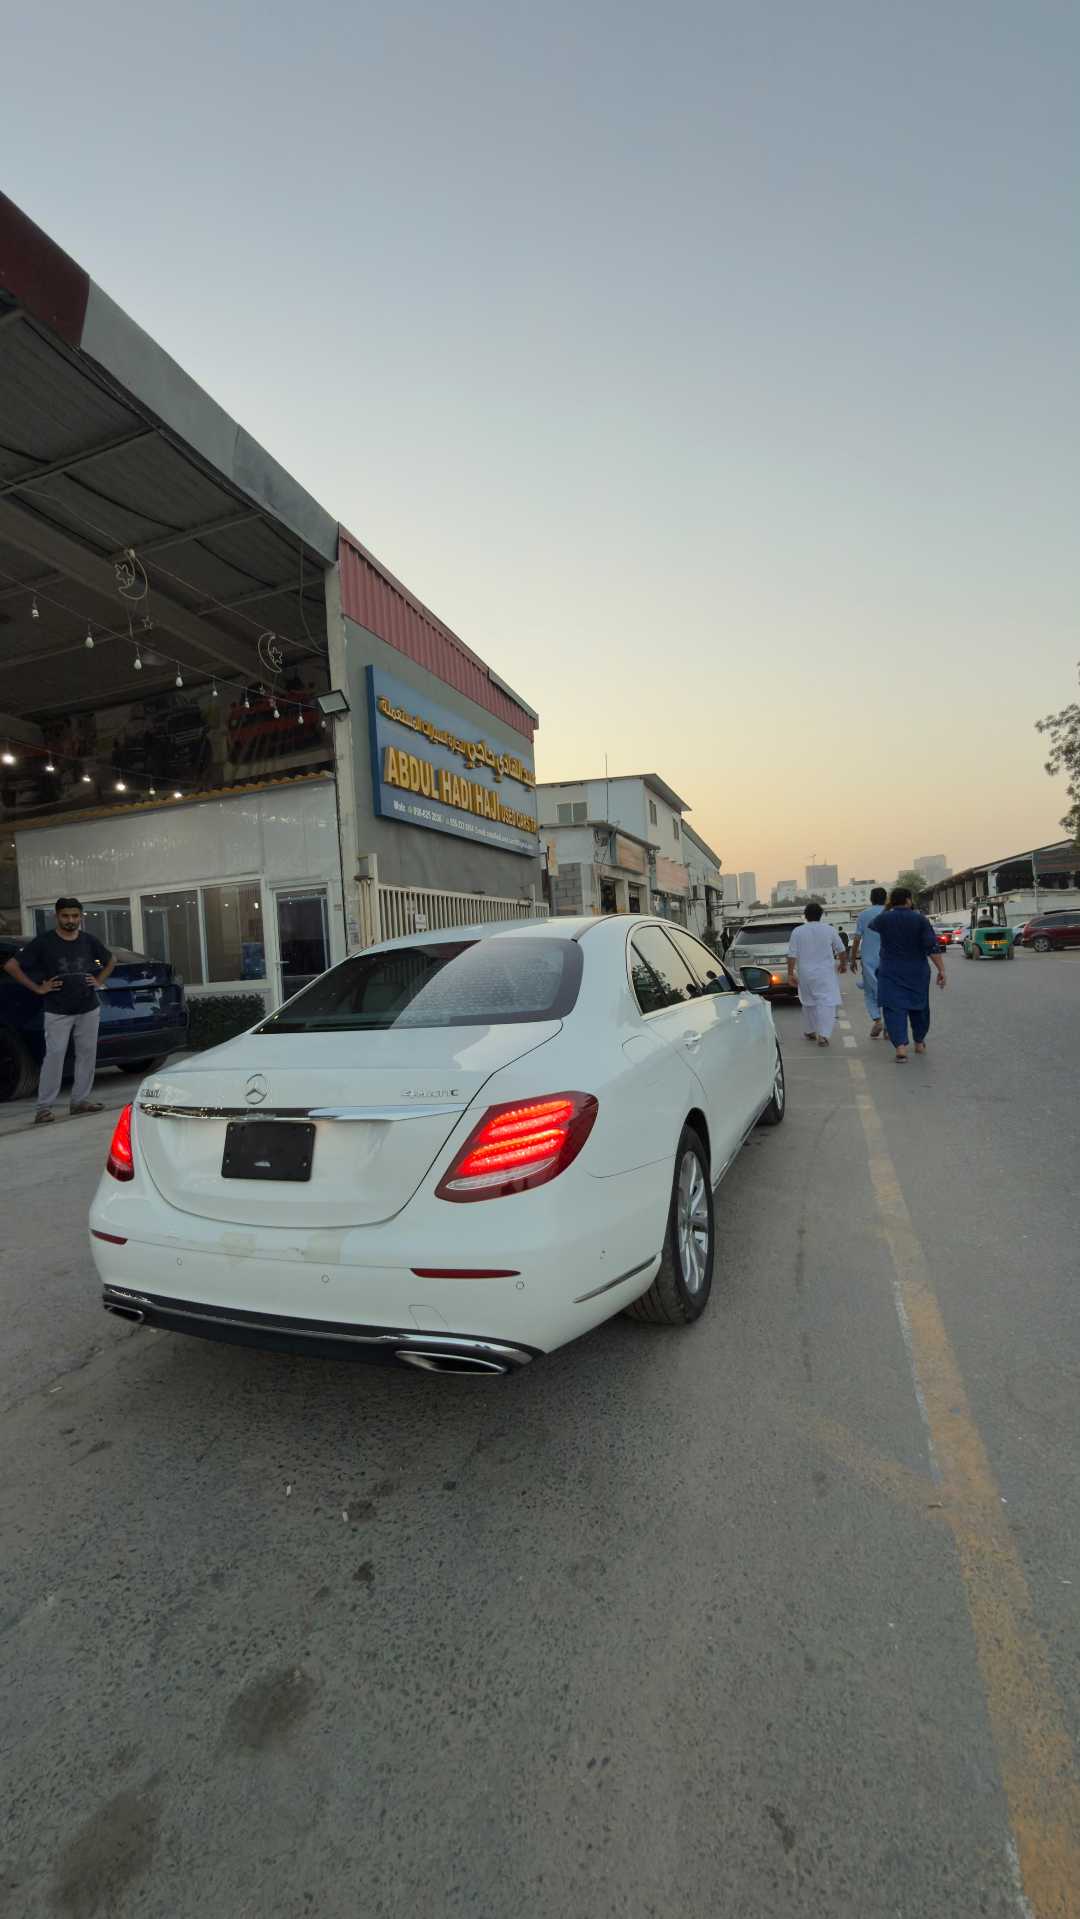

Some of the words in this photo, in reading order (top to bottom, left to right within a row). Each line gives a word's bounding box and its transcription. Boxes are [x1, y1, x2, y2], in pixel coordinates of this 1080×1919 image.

[385, 746, 439, 799] ABDUL
[440, 768, 473, 811] HADI
[474, 784, 500, 820] HAJI
